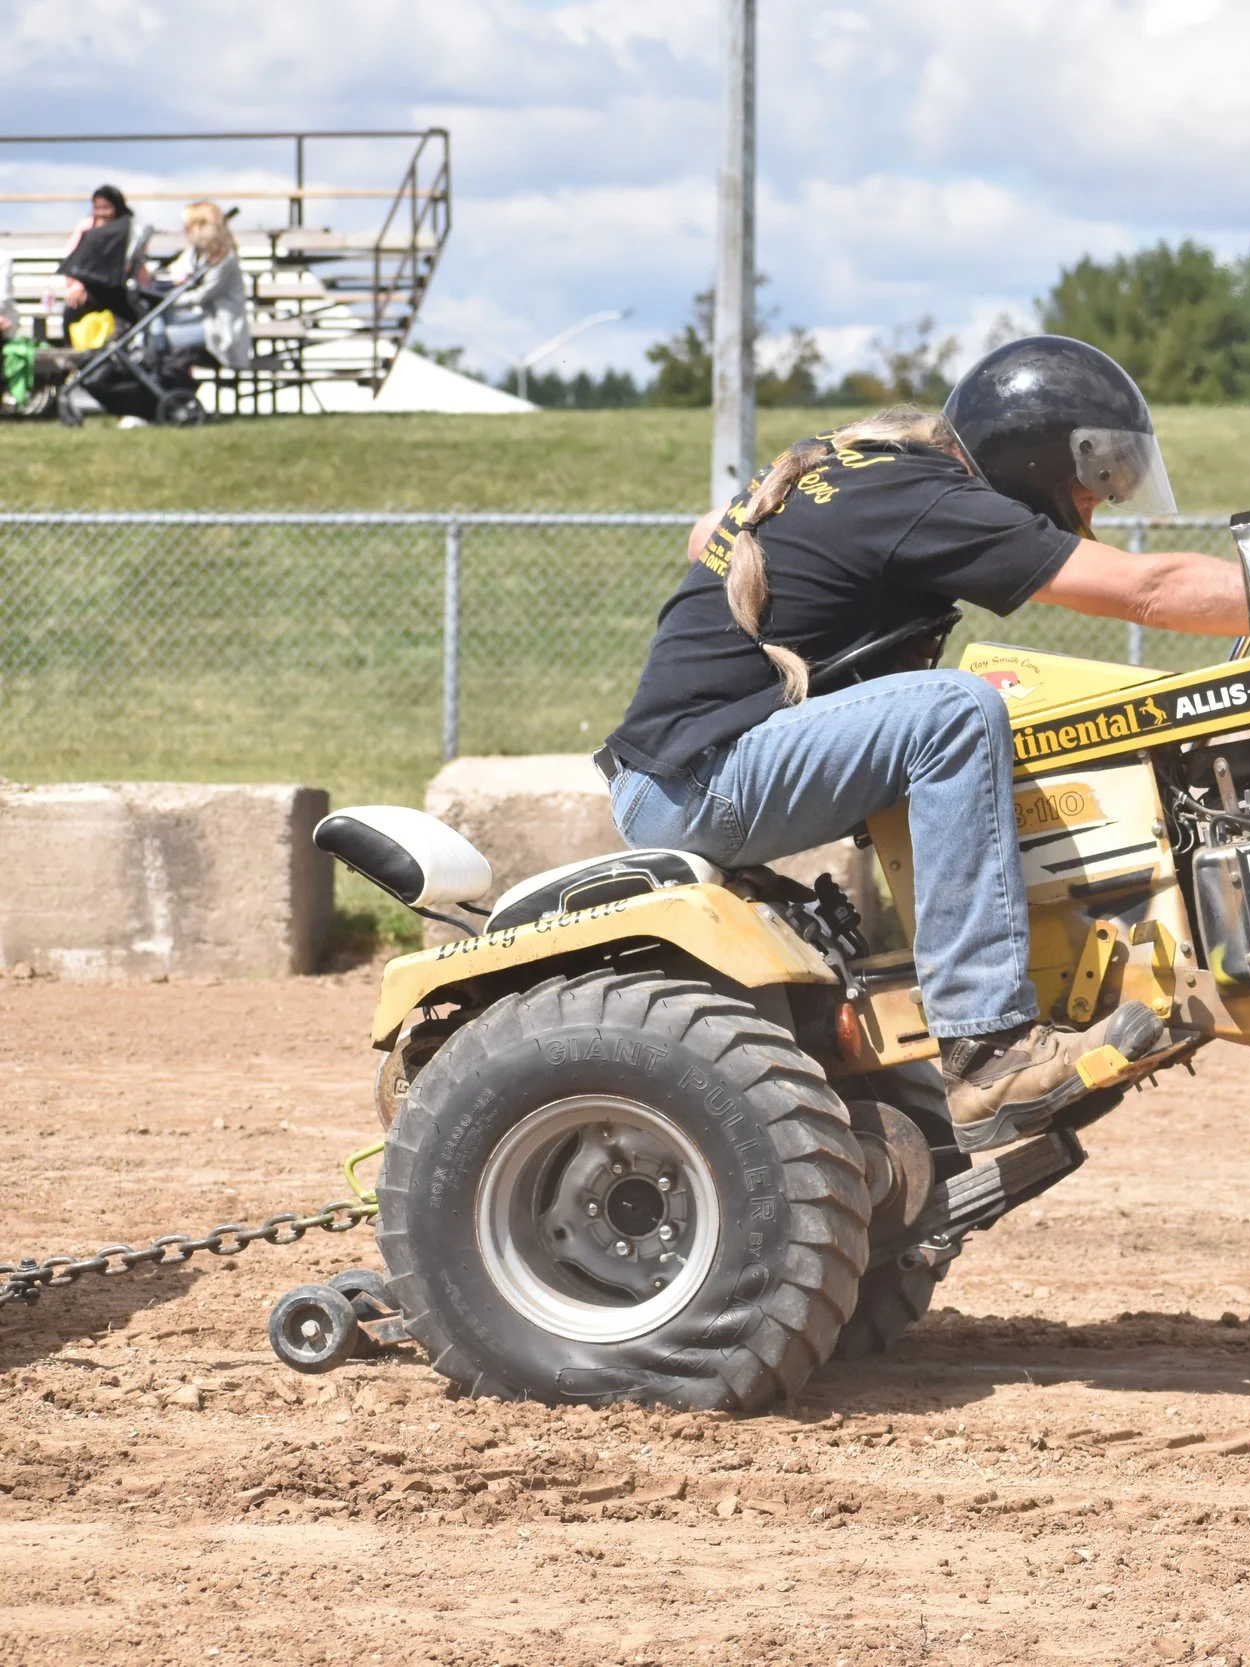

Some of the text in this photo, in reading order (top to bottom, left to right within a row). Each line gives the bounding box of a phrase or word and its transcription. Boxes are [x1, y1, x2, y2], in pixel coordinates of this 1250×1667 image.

[969, 660, 989, 673] Clay
[1020, 659, 1041, 674] Cams
[1012, 702, 1142, 761] tinental
[544, 1036, 669, 1073] GIANT
[678, 1064, 777, 1222] PULLER
[748, 1231, 764, 1257] BY
